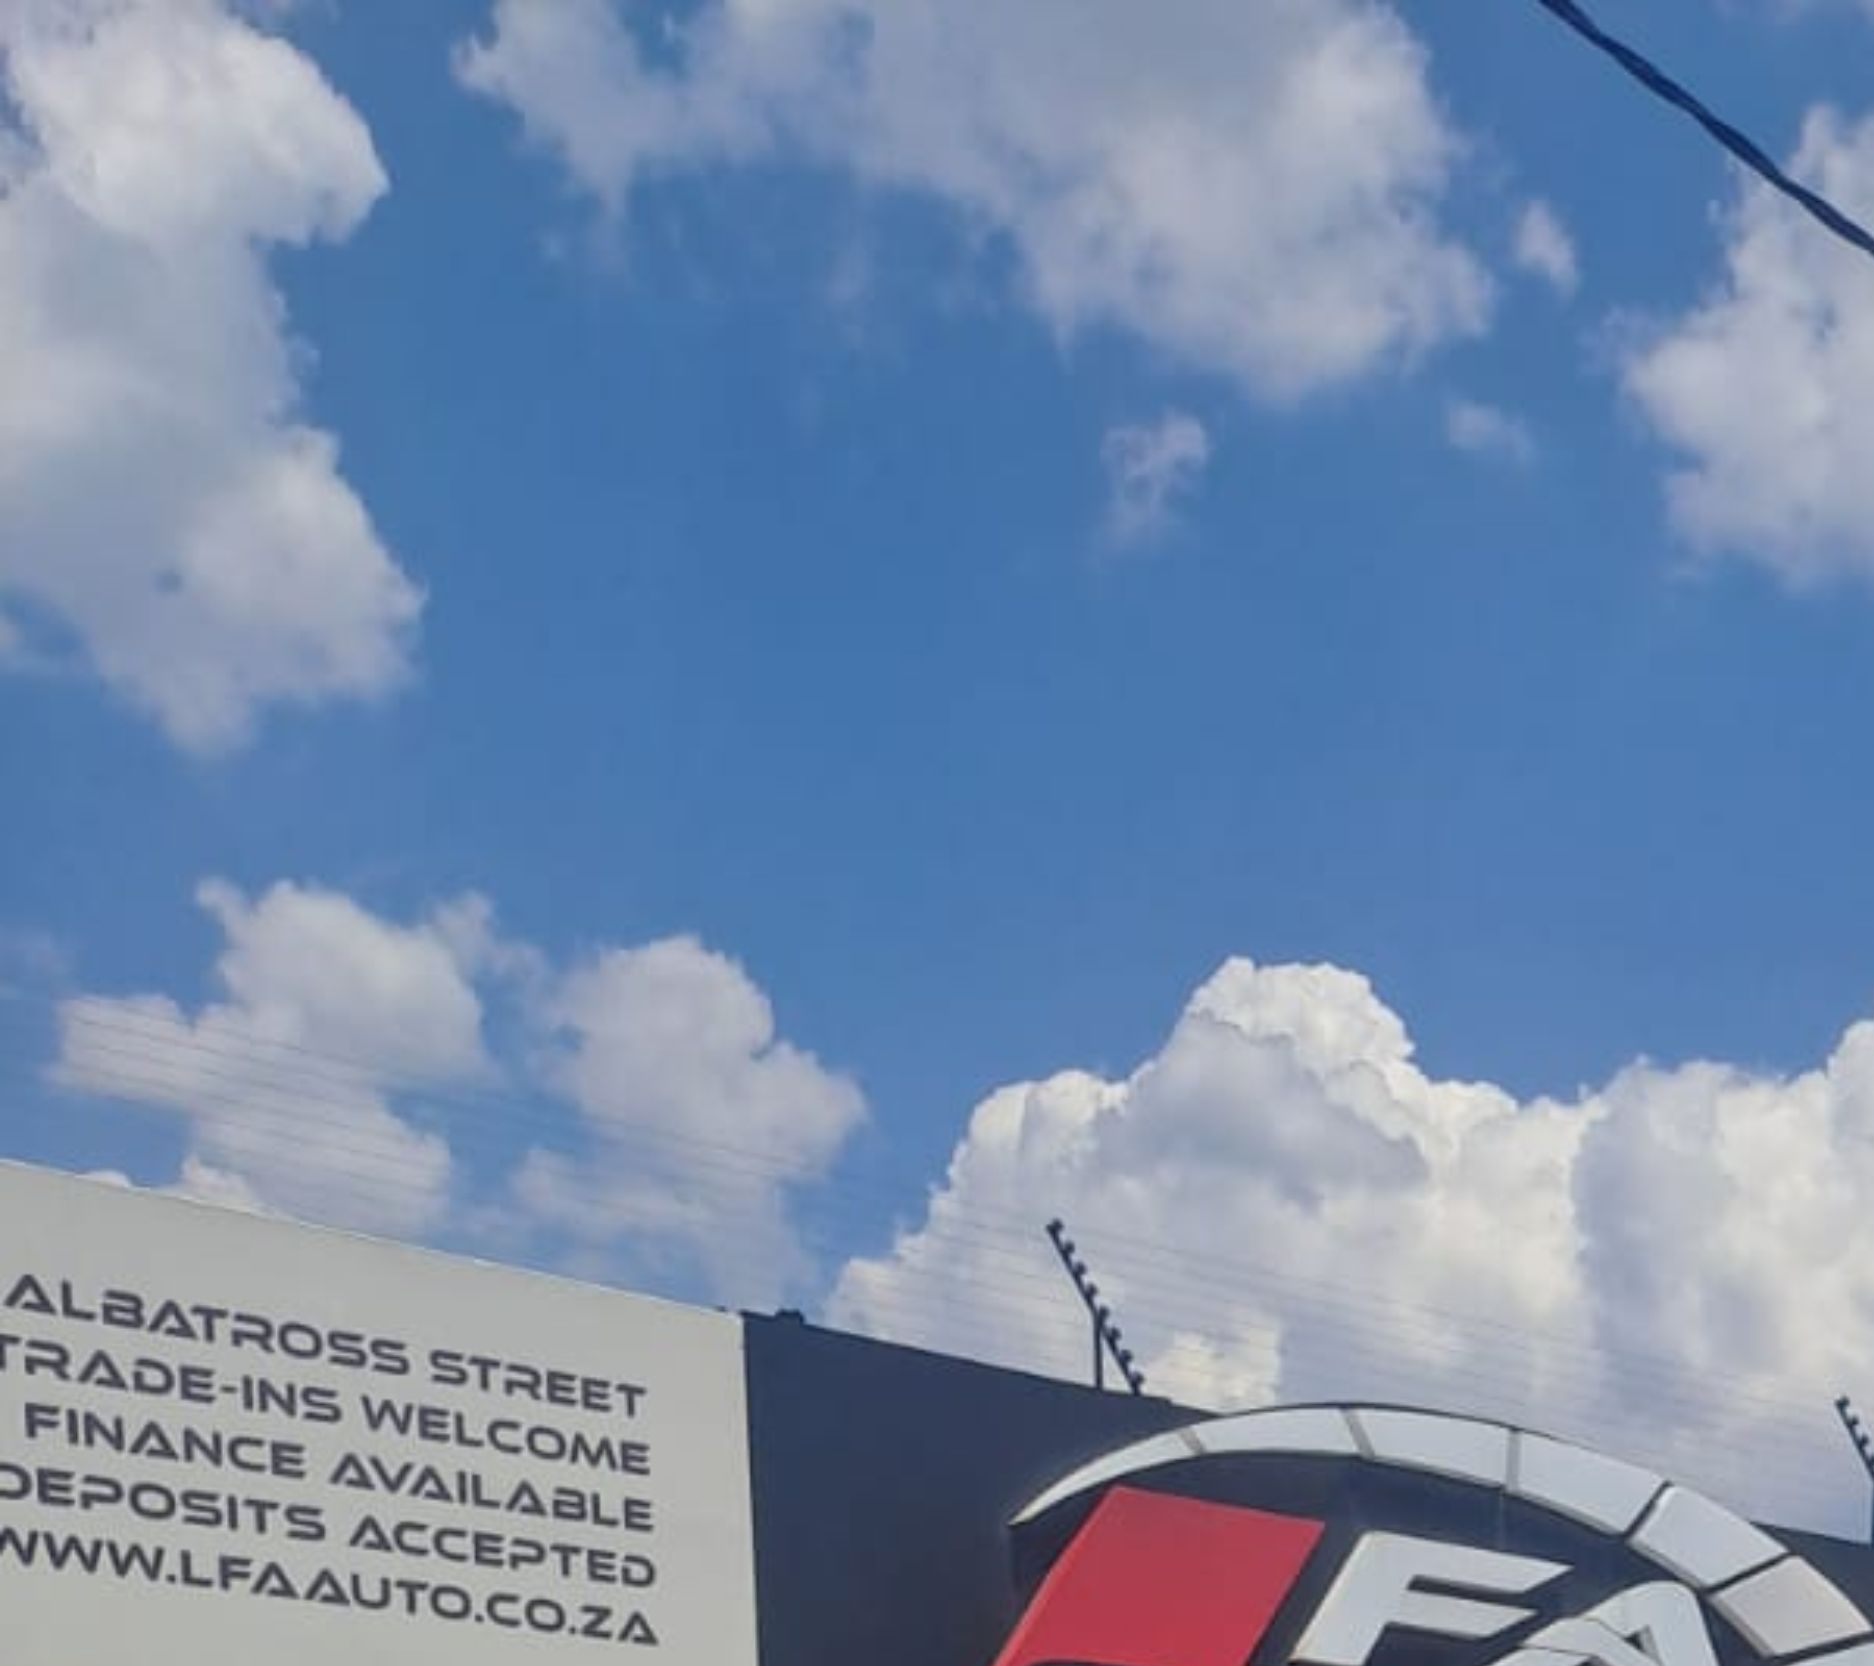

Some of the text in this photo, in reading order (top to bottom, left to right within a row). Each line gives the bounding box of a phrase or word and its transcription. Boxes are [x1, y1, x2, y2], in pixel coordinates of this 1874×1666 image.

[0, 1333, 651, 1476] TRADE-INS WELCOME
[4, 1273, 648, 1419] ALBATROSS STREET
[0, 1461, 657, 1589] DEPOSITS ACCEPTED
[24, 1401, 655, 1532] FINANCE AVAILABLE
[0, 1526, 659, 1647] WWW.LFAAUTO.CO.ZA
